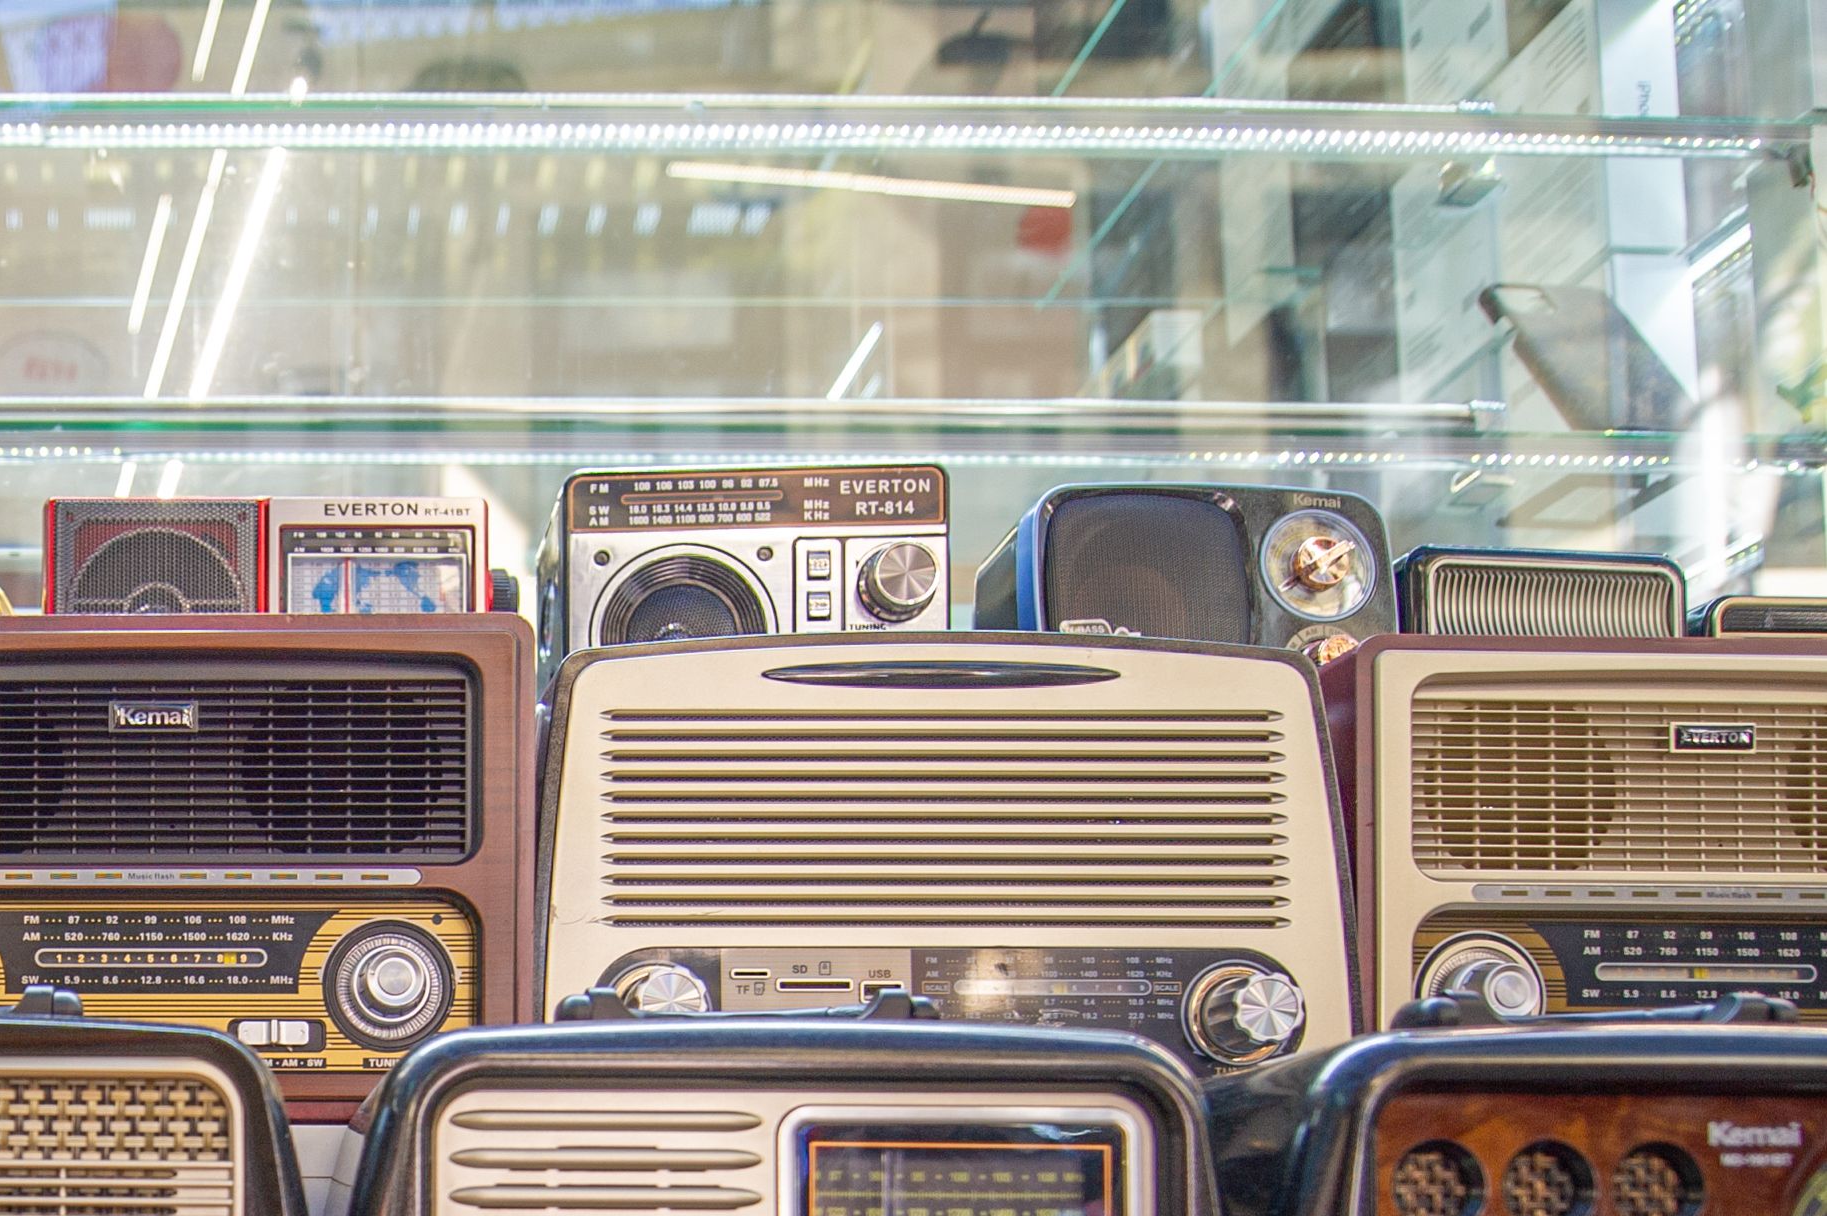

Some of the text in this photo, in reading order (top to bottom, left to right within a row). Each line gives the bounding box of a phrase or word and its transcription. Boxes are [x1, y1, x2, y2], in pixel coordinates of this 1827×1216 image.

[699, 481, 716, 490] 100
[804, 478, 829, 487] MHz
[840, 479, 930, 494] EVERTON
[1293, 494, 1341, 508] Kemai
[324, 503, 471, 516] EVERTON RT-41BT
[589, 500, 829, 514] SW 14.4 MHz
[855, 501, 914, 515] RT-814
[589, 517, 609, 525] AM
[676, 515, 695, 523] 1100
[804, 512, 829, 520] KHz
[120, 708, 192, 726] Kemai
[24, 916, 294, 924] FM 87 92 99 106 108 MHz
[23, 932, 293, 941] AM 520 760 1150 1500 1620 KHz
[1584, 930, 1600, 939] FM
[1627, 930, 1639, 939] 87
[1780, 932, 1797, 941] 108
[1584, 947, 1800, 957] AM 520 760 1150 1500 1620
[56, 954, 247, 963] 1 2 3 4 5 6 7 8 9
[792, 965, 808, 974] SD
[868, 970, 891, 978] USB
[21, 976, 293, 984] SW 5.9 8.6 12.8 16.6 18.0 MHz
[736, 985, 750, 994] TF
[1582, 990, 1600, 998] SW
[281, 1058, 323, 1067] AM SW
[1707, 1121, 1803, 1147] Kemai
